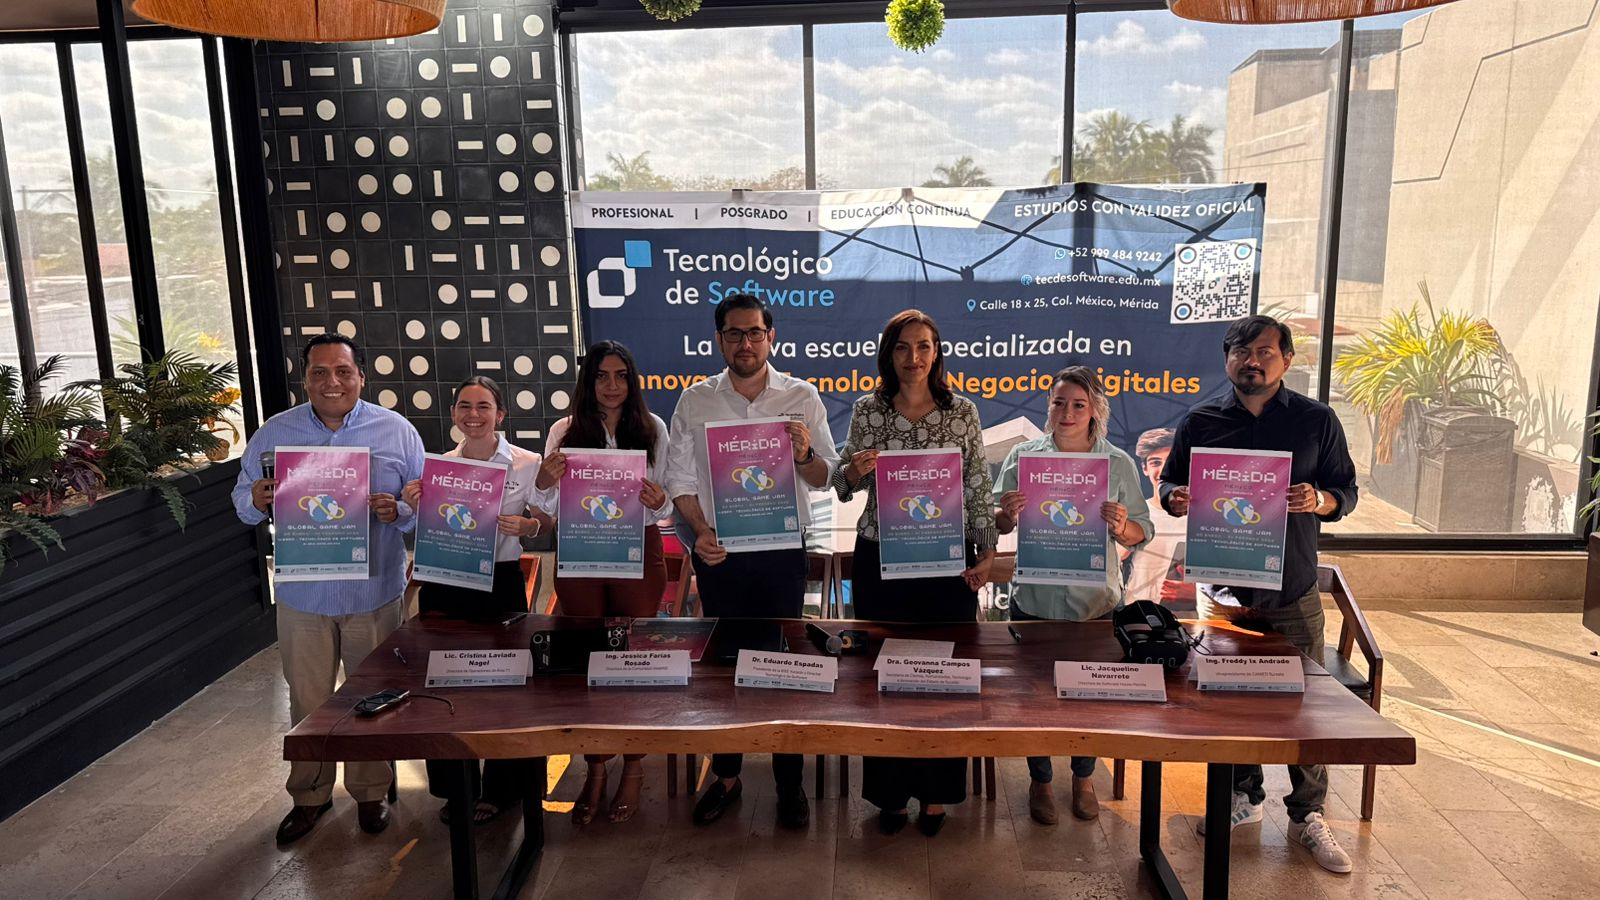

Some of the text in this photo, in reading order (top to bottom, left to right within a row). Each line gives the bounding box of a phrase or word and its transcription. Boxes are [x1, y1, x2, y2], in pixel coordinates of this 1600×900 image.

[592, 203, 970, 220] PROFESIONAL POSGRADO EDUCACIÓN CONTINUA
[1015, 200, 1255, 218] ESTUDIOS CON VALIDEZ OFICIAL
[663, 246, 833, 281] Tecnológico
[1068, 248, 1162, 262] +52 999 484 9242
[1035, 272, 1161, 287] tecdesoftware.edu.mx
[665, 279, 699, 304] de
[979, 299, 1007, 310] Calle
[1011, 299, 1022, 309] 18
[1033, 298, 1048, 309] 25,
[1051, 295, 1072, 306] Col.
[1075, 295, 1117, 308] México,
[1119, 298, 1159, 310] Mérida
[684, 335, 712, 356] La
[805, 333, 883, 358] escue
[940, 330, 1132, 360] pecializada en
[946, 368, 1054, 399] Negocio
[1097, 367, 1201, 397] igitales
[763, 658, 792, 666] Eduardo
[794, 661, 823, 669] Espadas
[913, 667, 944, 675] Vázquez
[941, 660, 970, 668] Campos
